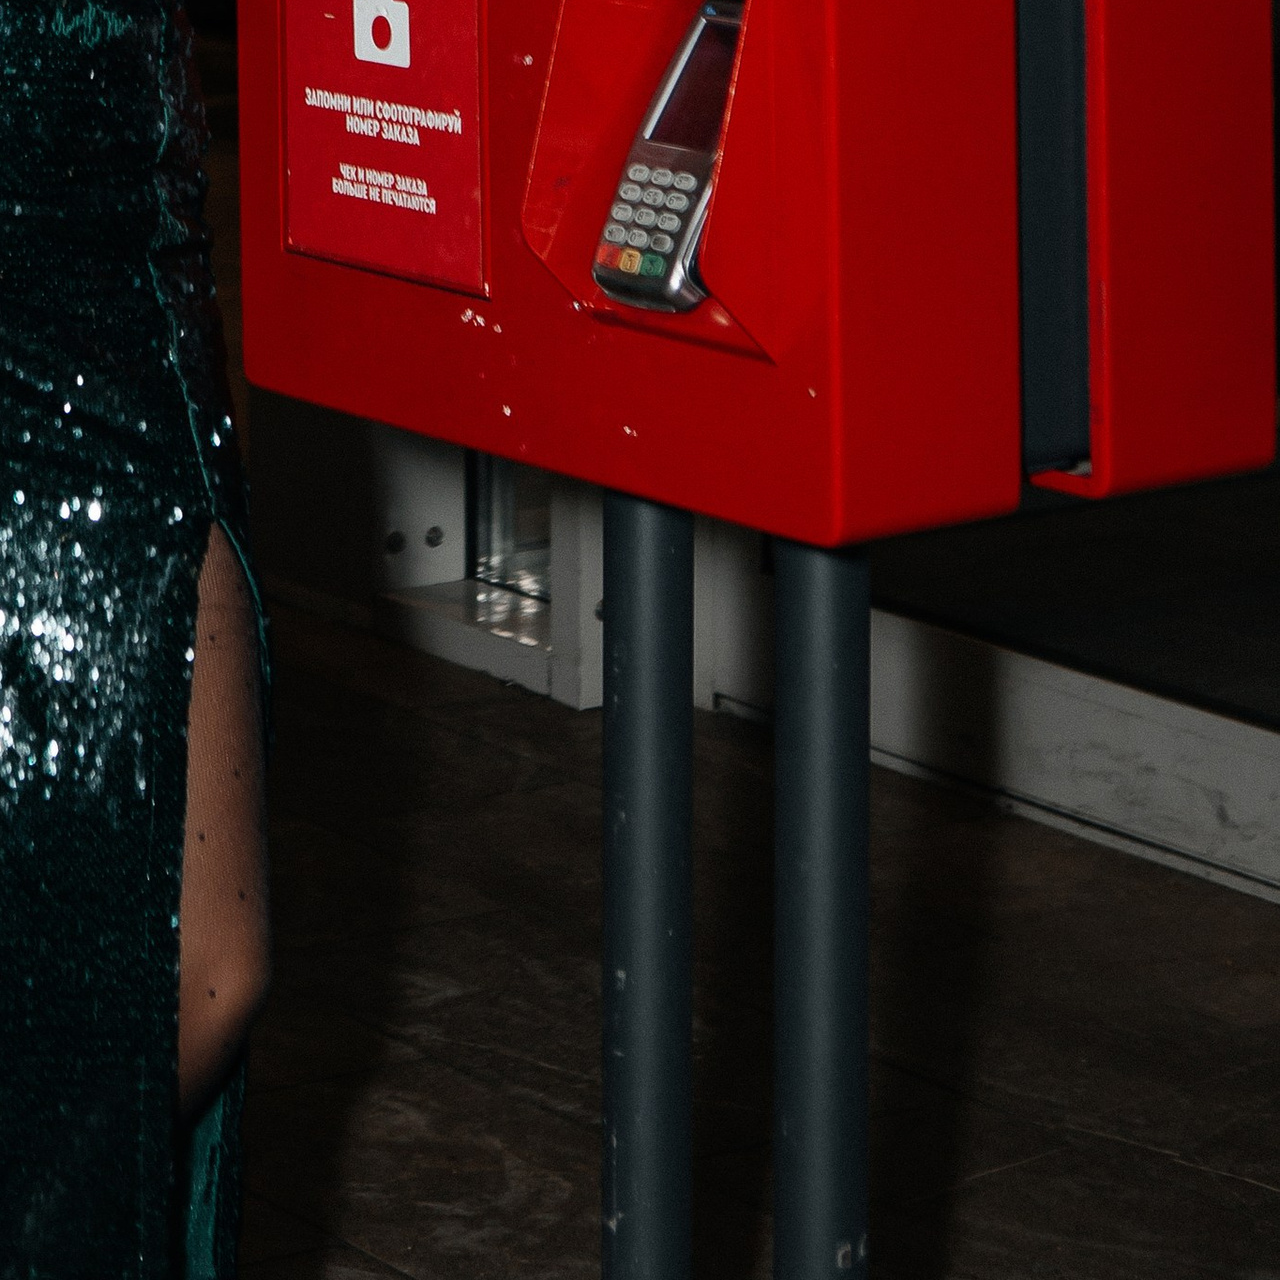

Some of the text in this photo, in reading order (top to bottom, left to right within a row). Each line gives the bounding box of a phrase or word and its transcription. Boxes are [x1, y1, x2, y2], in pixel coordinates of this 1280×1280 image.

[305, 86, 462, 134] ЗАПОМНИ ИЛИ СФОТОГРАФИРУЙ
[346, 114, 420, 146] НОМЕР ЗАКАЗА
[332, 177, 437, 215] БОЛЬШЕ НЕ ПЕЧАТАЮТСЯ
[339, 162, 428, 196] ЧЕК И НОМЕР ЗАКАЗА
